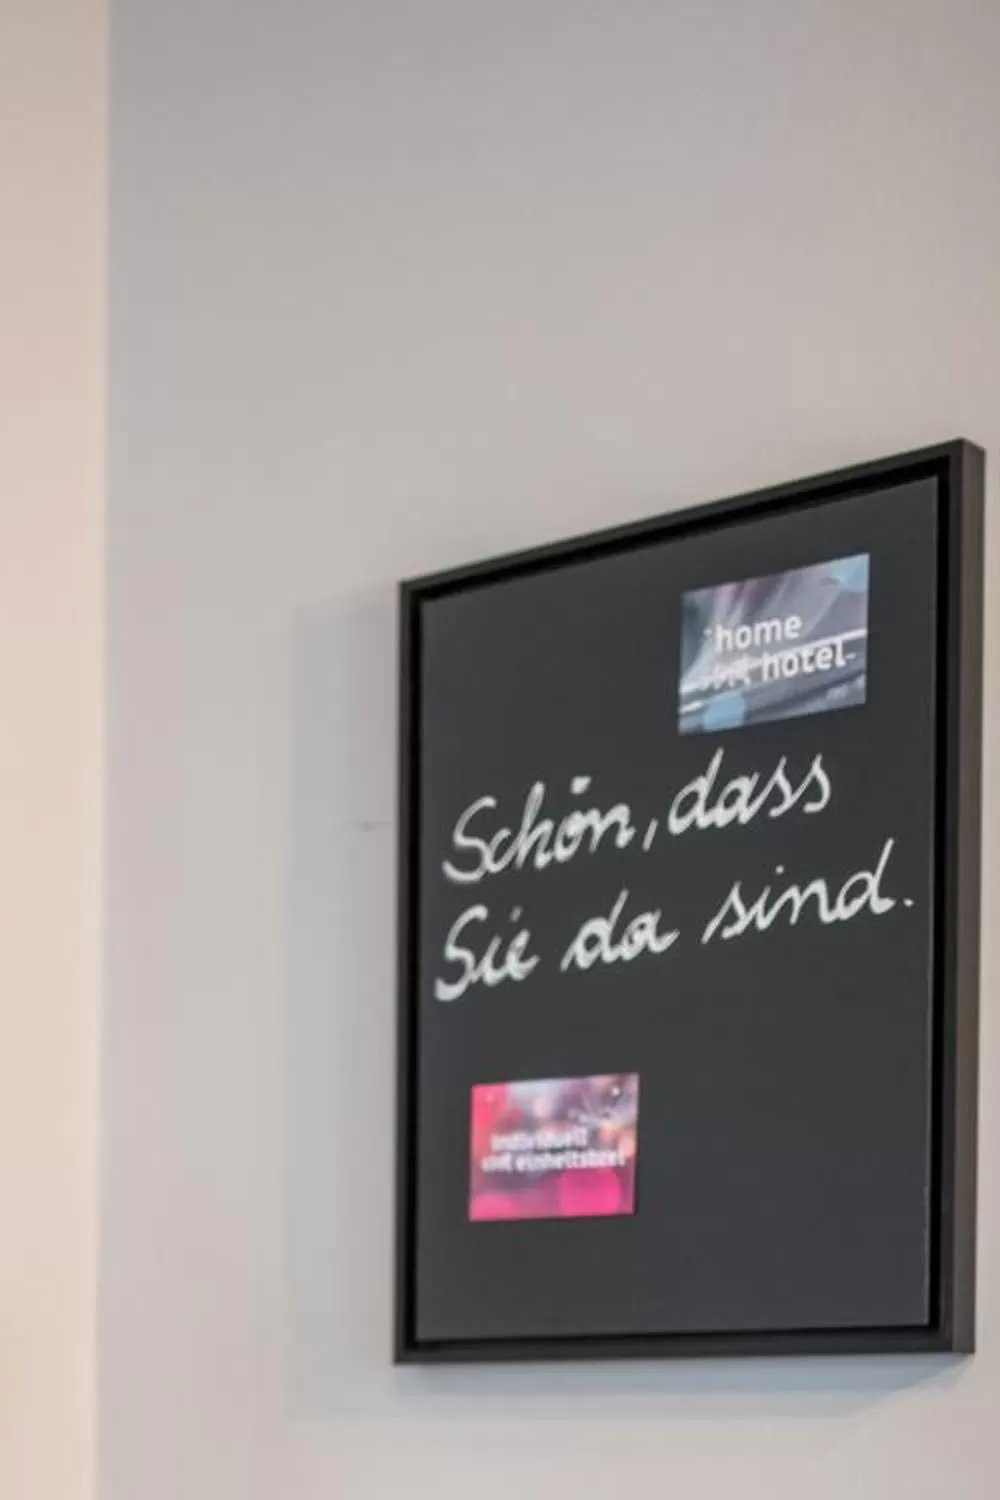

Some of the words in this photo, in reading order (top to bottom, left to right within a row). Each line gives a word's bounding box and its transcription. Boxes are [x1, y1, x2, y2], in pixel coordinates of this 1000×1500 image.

[667, 747, 832, 835] dass
[435, 904, 541, 1001] Sie
[560, 889, 681, 973] da
[701, 837, 914, 945] sind.
